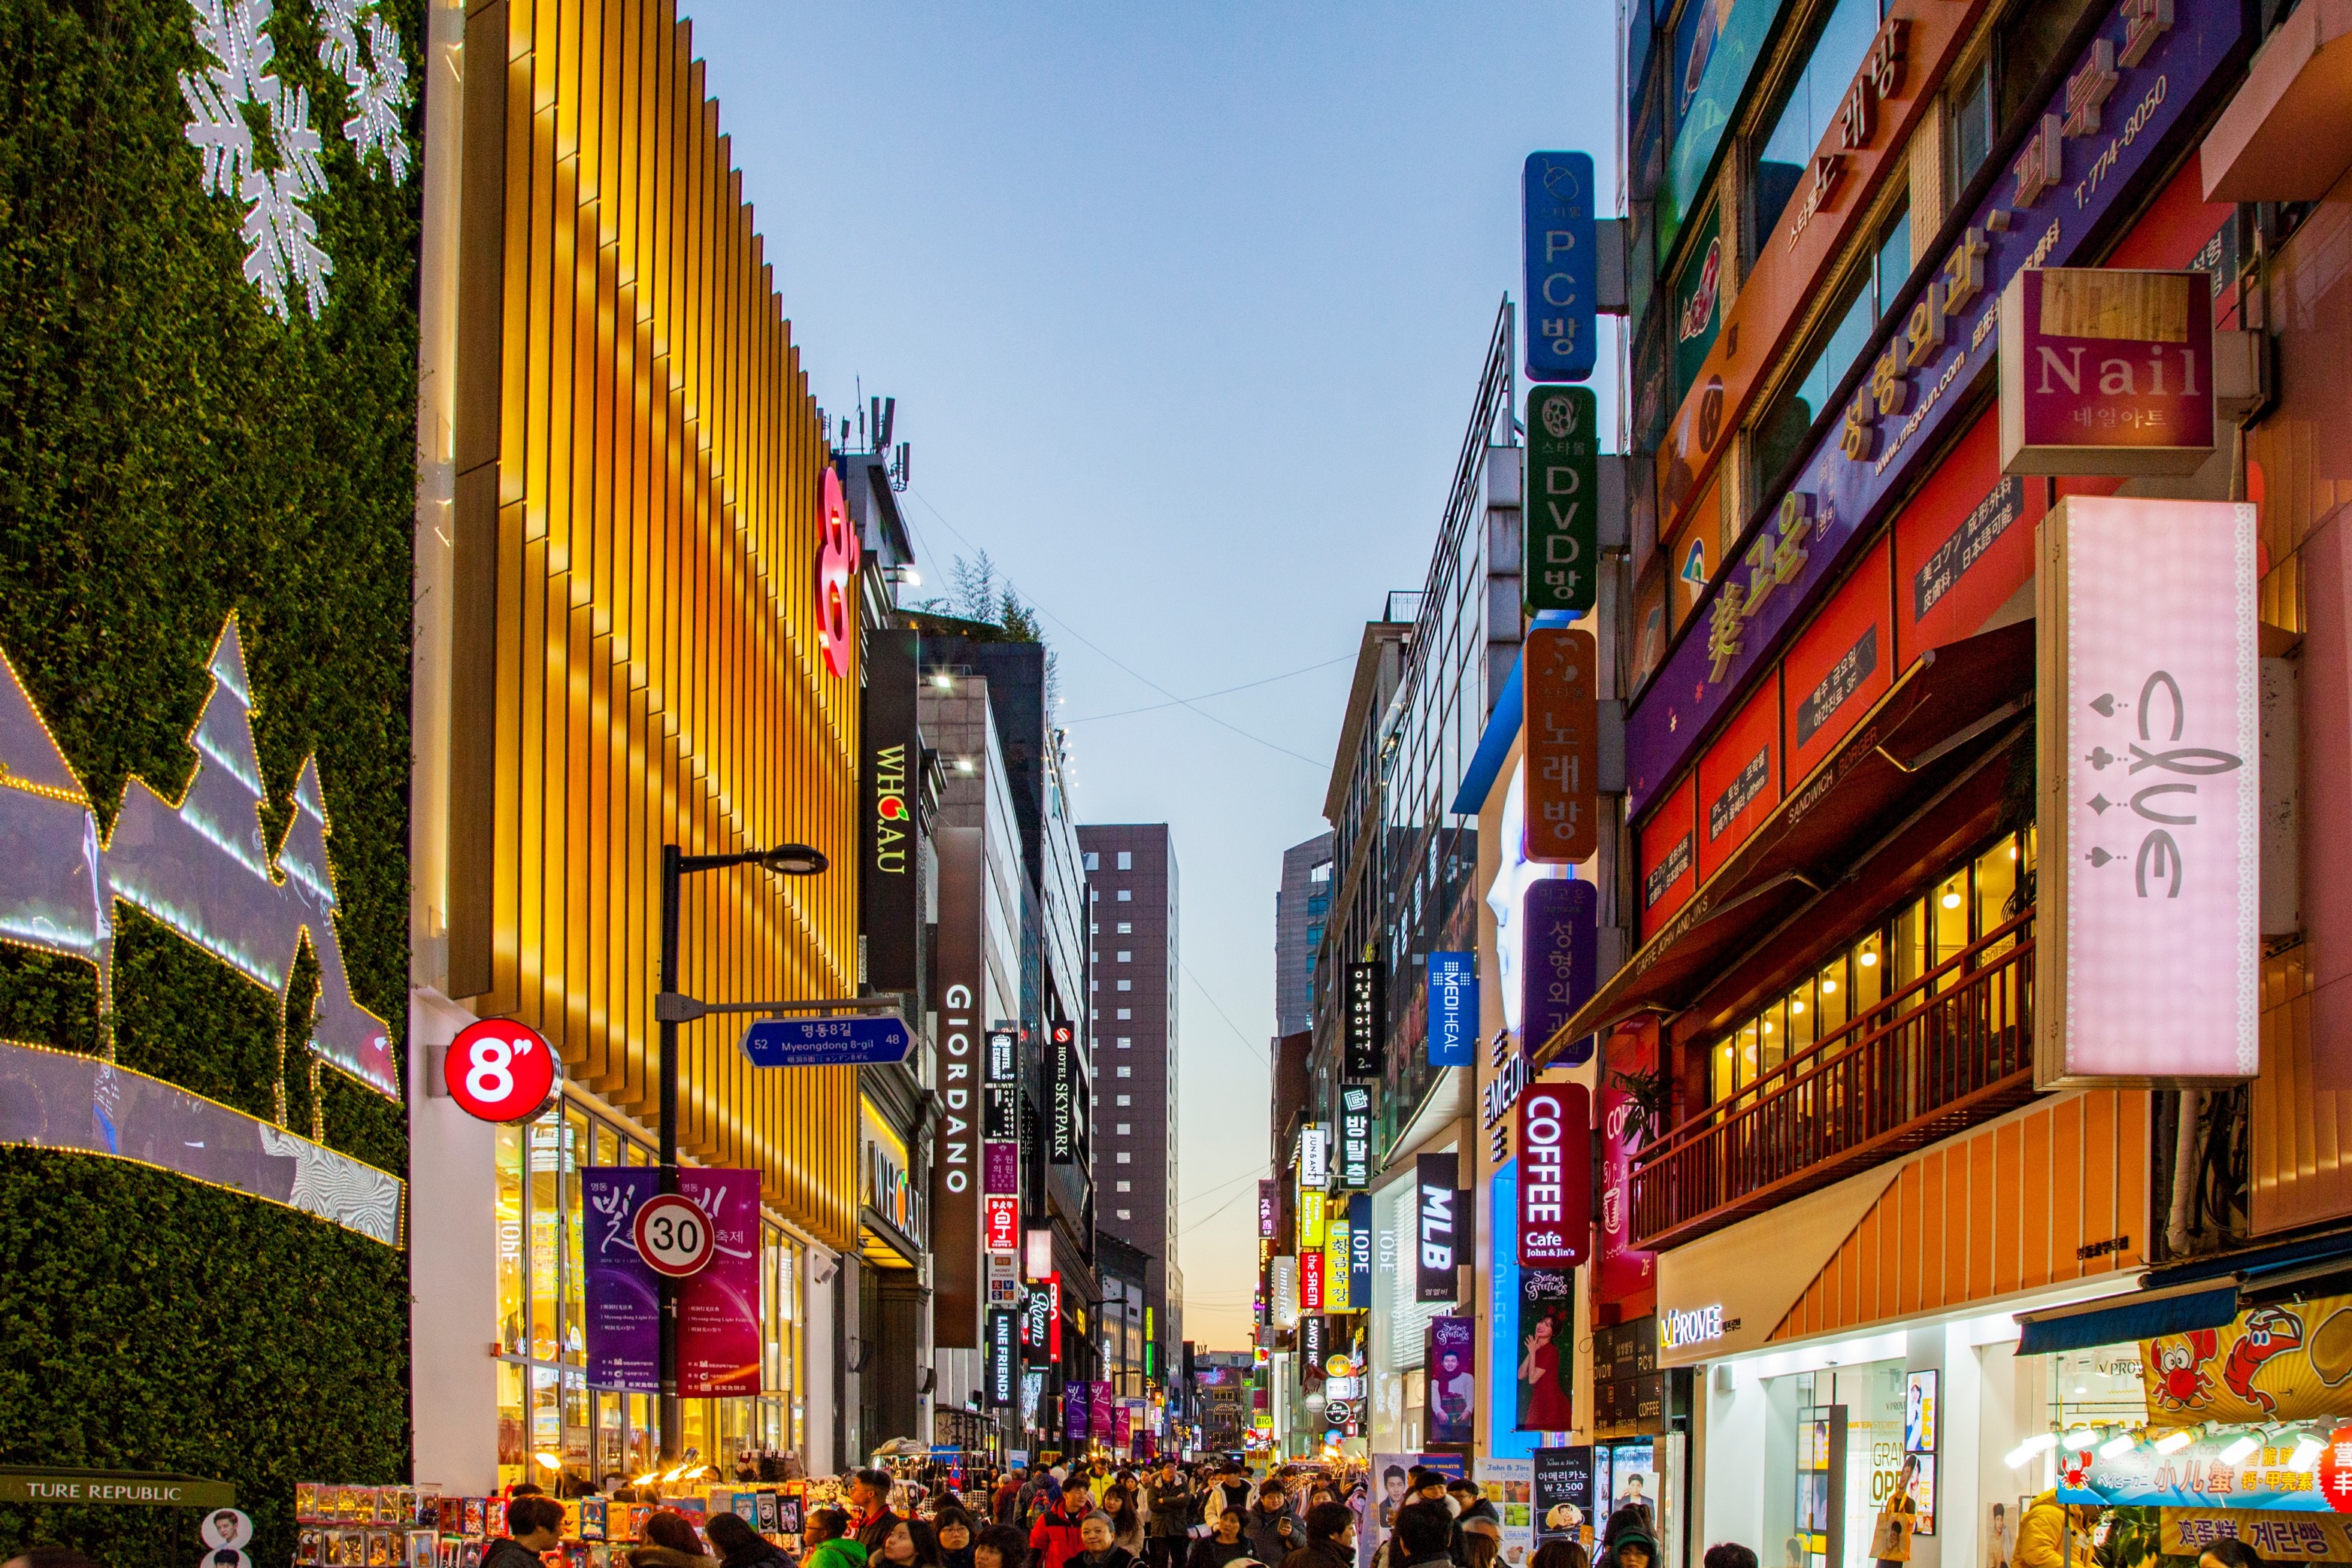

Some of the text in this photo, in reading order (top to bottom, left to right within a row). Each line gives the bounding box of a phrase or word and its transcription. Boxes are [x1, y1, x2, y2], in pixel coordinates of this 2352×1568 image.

[1815, 18, 1912, 212] 노래방
[2036, 345, 2201, 396] Nail
[1875, 351, 1966, 477] www.migoun.com
[2074, 407, 2167, 429] 네일아트
[1968, 477, 2011, 538] 成形外科
[1963, 503, 2013, 570] 日本語可能
[1814, 647, 1856, 705] 매주 금요일
[1814, 672, 1857, 727] 야간진료 3F
[1542, 711, 1582, 841] 노래방
[1788, 768, 1833, 825] SANDWICH
[801, 1023, 852, 1038] 명동8길
[1445, 972, 1459, 1053] MEDIHEAL
[754, 1039, 767, 1049] 52
[782, 1040, 873, 1052] Myeongdong 8-gil
[885, 1034, 899, 1044] 48
[946, 984, 971, 1194] GIORDANO
[1055, 1046, 1068, 1158] HOTEL SKYPARK
[1491, 1051, 1529, 1122] MEDI
[993, 1164, 1013, 1174] 의원
[1527, 1096, 1561, 1223] COFFEE
[590, 1182, 607, 1191] 명동
[682, 1183, 698, 1192] 명동
[653, 1216, 698, 1253] 30
[1421, 1185, 1452, 1270] MLB
[1526, 1232, 1562, 1246] Cafe
[1353, 1230, 1370, 1273] IOPE
[1527, 1249, 1547, 1258] John
[1556, 1248, 1576, 1258] Jin's
[1642, 1258, 1650, 1276] 2F
[1308, 1255, 1318, 1306] the SAEM
[1029, 1292, 1049, 1347] Roem
[1307, 1318, 1318, 1350] SAVOY
[997, 1316, 1008, 1401] LINE FRIENDS
[1638, 1401, 1659, 1417] COFFEE
[89, 1485, 182, 1501] REPUBLIC
[1538, 1470, 1588, 1482] 아메리카노
[1556, 1482, 1583, 1492] 2,500
[2154, 1458, 2234, 1493] 小儿蟹
[2250, 1521, 2329, 1557] 계란빵
